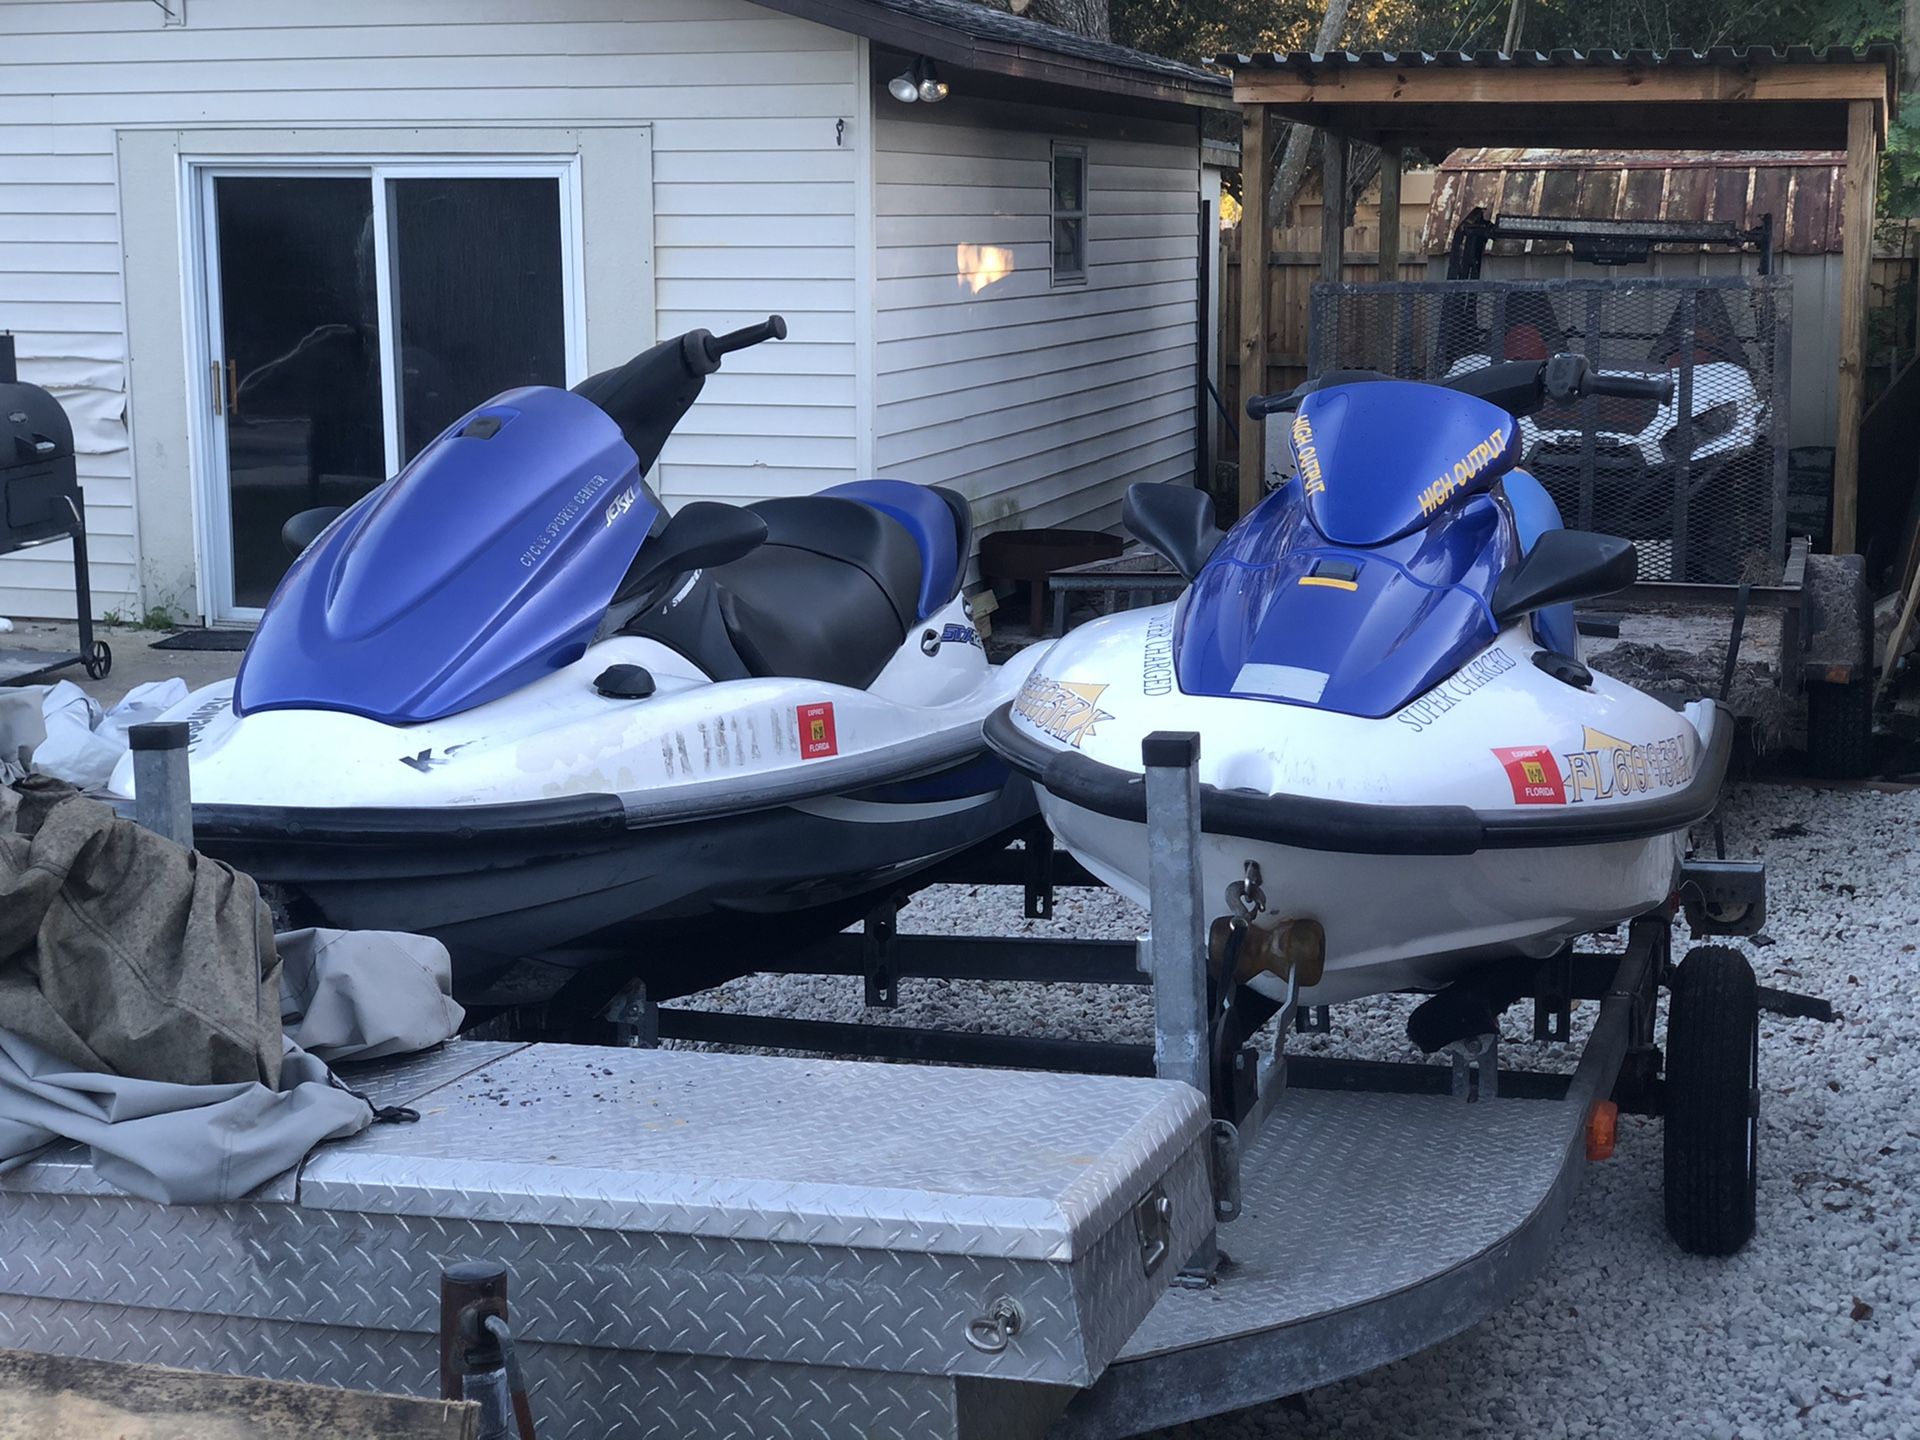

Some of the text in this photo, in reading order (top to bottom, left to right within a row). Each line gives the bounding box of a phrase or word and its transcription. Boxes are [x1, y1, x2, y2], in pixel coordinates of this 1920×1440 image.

[1292, 414, 1326, 496] HIGH OUTPUT
[1416, 427, 1508, 518] HIGH OUTPUT
[519, 474, 609, 567] CYCLE SPORTS CENTER
[1143, 640, 1172, 697] CHARGED
[1396, 646, 1518, 733] SUPER CHARGED
[809, 741, 830, 753] FLORIDA
[1524, 786, 1556, 798] FLORIDA
